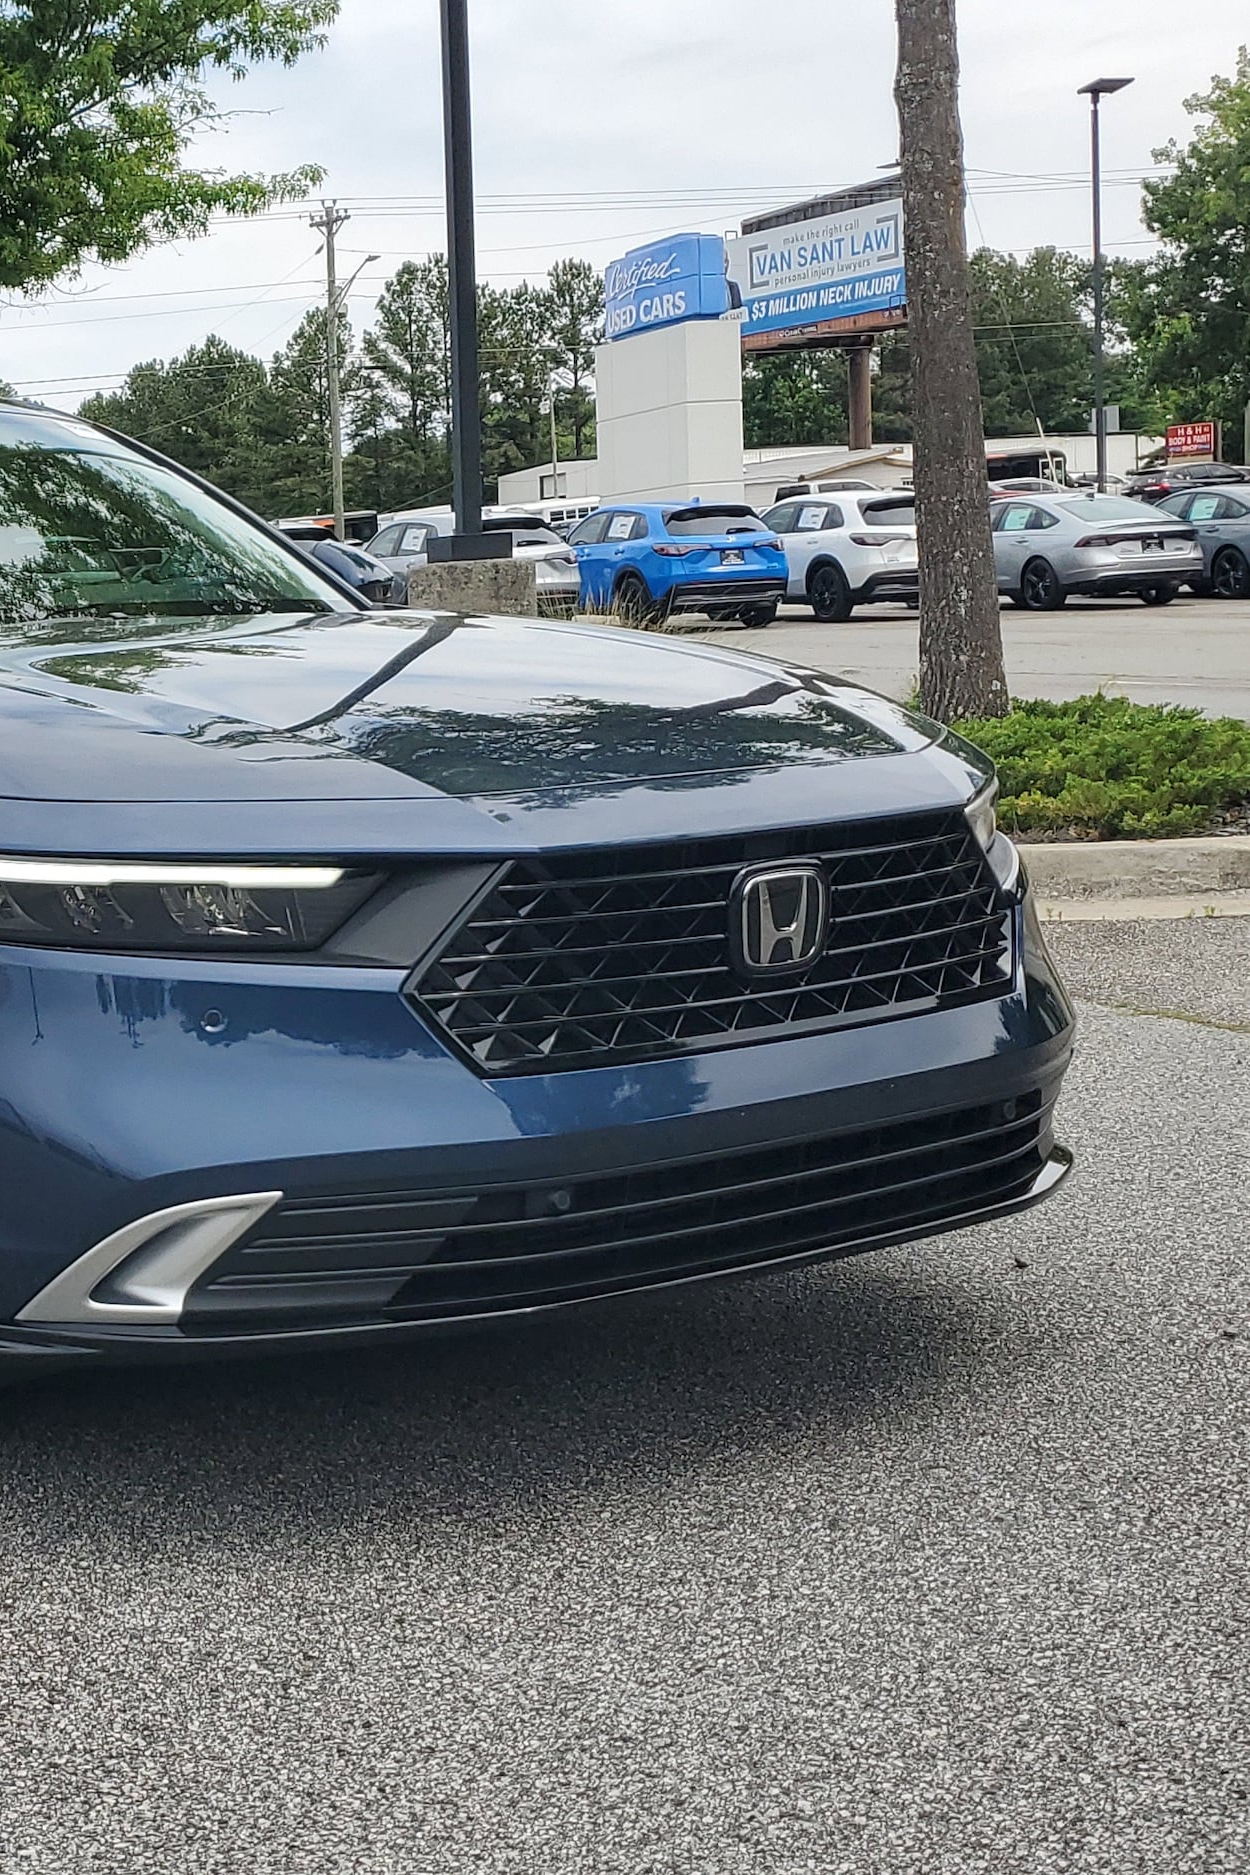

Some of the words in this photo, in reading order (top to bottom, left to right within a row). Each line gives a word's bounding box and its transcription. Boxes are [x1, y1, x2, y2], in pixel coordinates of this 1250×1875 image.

[756, 248, 792, 276] VAN
[797, 237, 845, 267] SANT
[850, 226, 891, 257] LAW
[783, 231, 804, 246] make
[806, 228, 820, 241] the
[821, 224, 842, 238] right
[844, 218, 860, 232] call
[610, 252, 680, 301] Certified
[774, 271, 810, 288] personal
[810, 265, 835, 280] injury
[837, 258, 871, 273] lawyers
[608, 304, 637, 334] USED
[639, 291, 686, 323] CARS
[751, 300, 767, 322] $3
[768, 290, 817, 317] MILLION
[818, 284, 853, 306] NECK
[854, 273, 901, 299] INJURY
[1177, 427, 1185, 436] H
[1186, 426, 1193, 435] &
[1195, 426, 1202, 434] H
